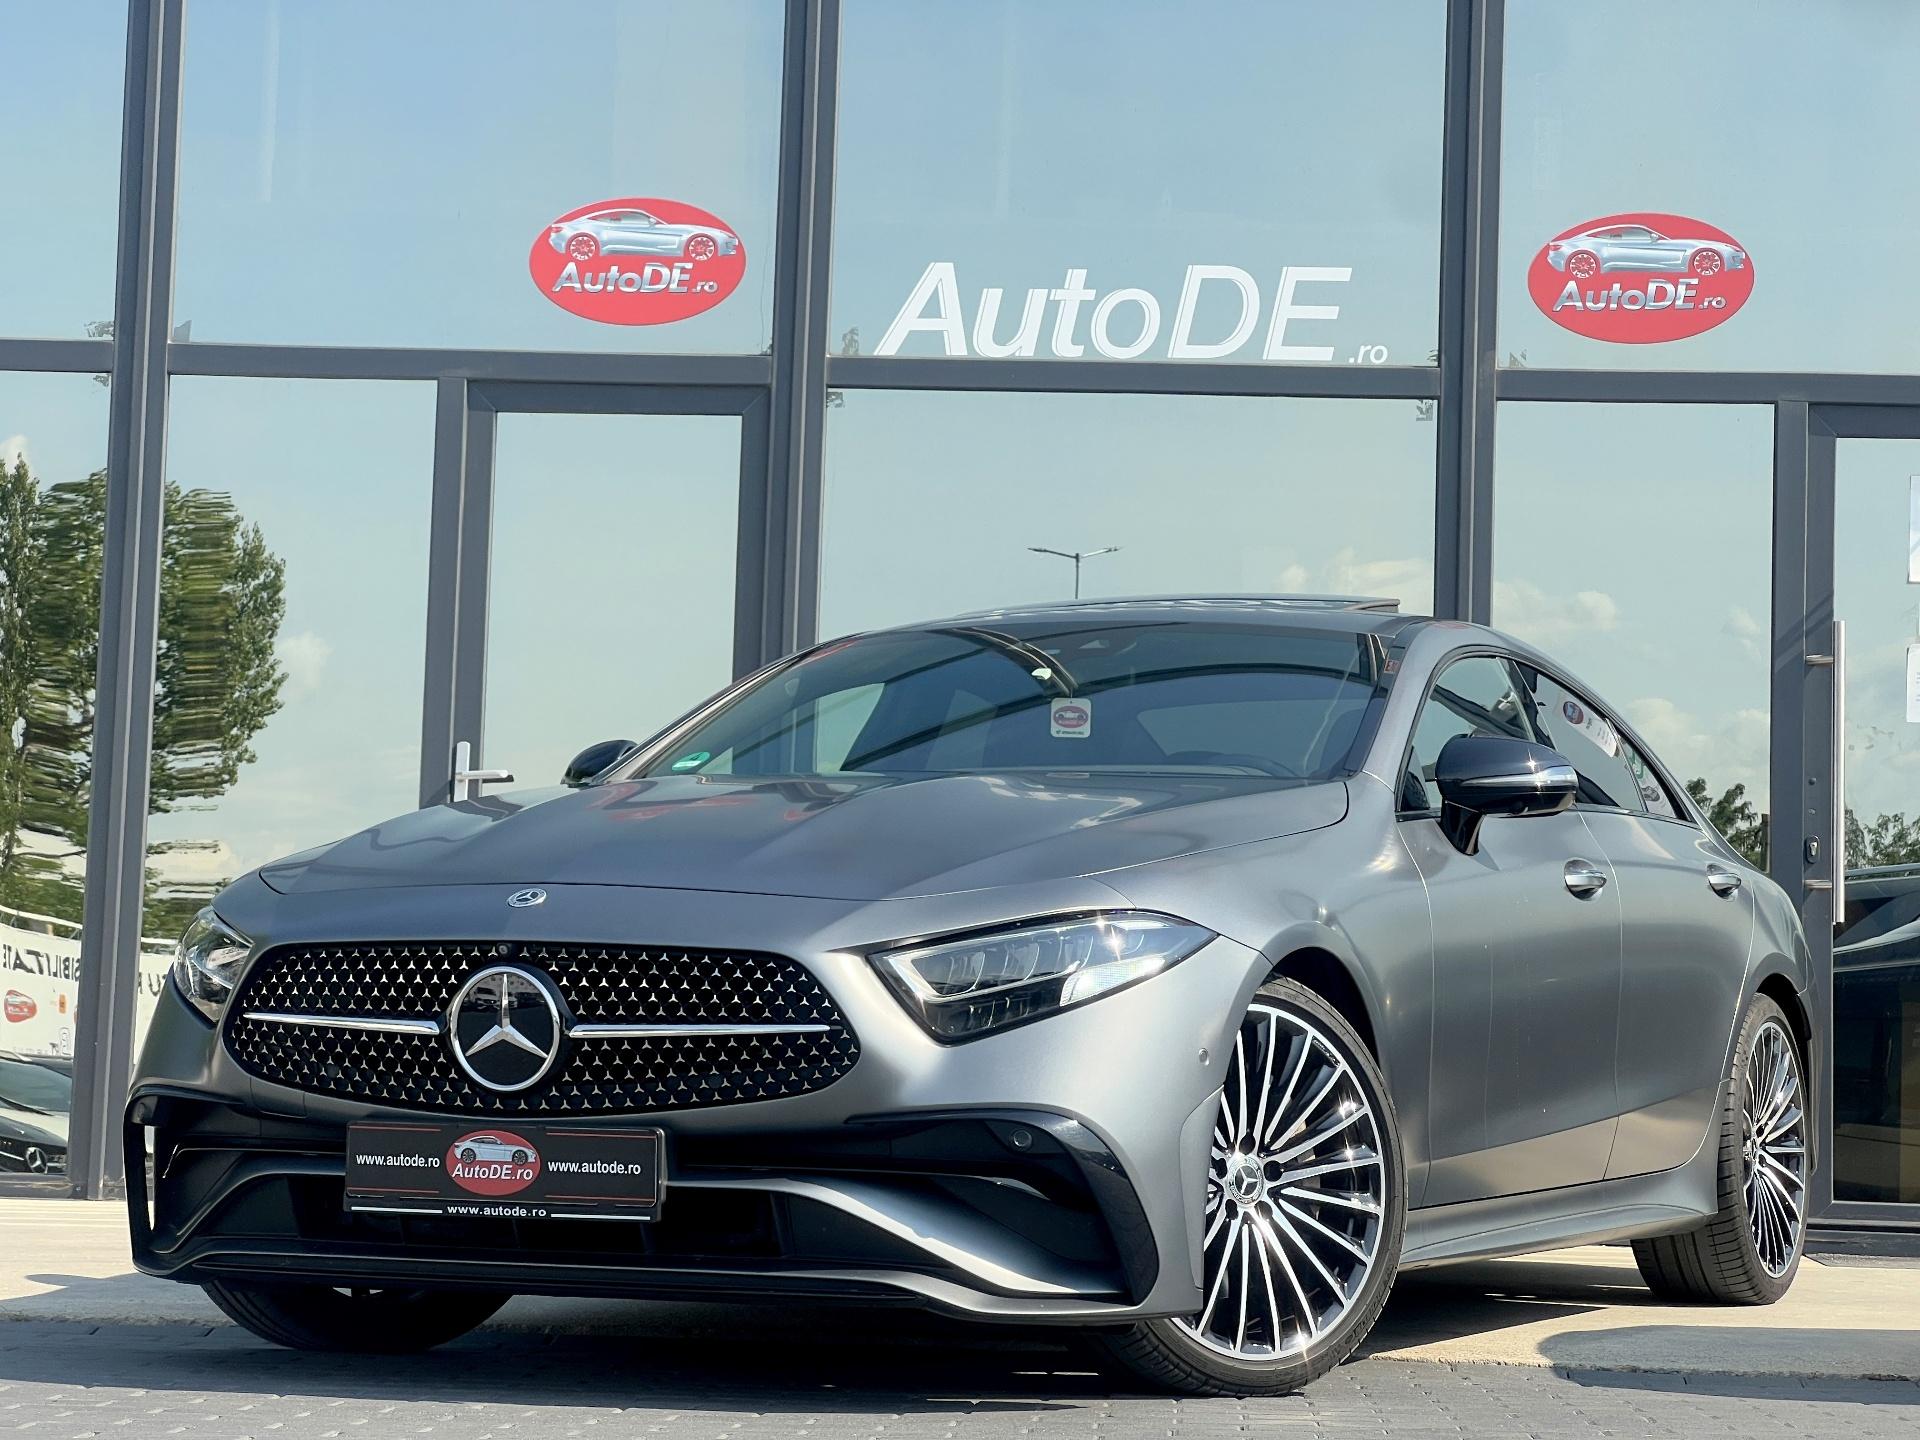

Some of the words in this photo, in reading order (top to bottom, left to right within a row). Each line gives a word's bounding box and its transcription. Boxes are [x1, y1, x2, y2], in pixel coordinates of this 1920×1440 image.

[356, 1153, 441, 1168] www.autode.ro
[547, 1160, 642, 1175] www.autode.ro
[452, 1162, 534, 1181] AutoDE.ro
[447, 1206, 548, 1218] www.autode.ro
